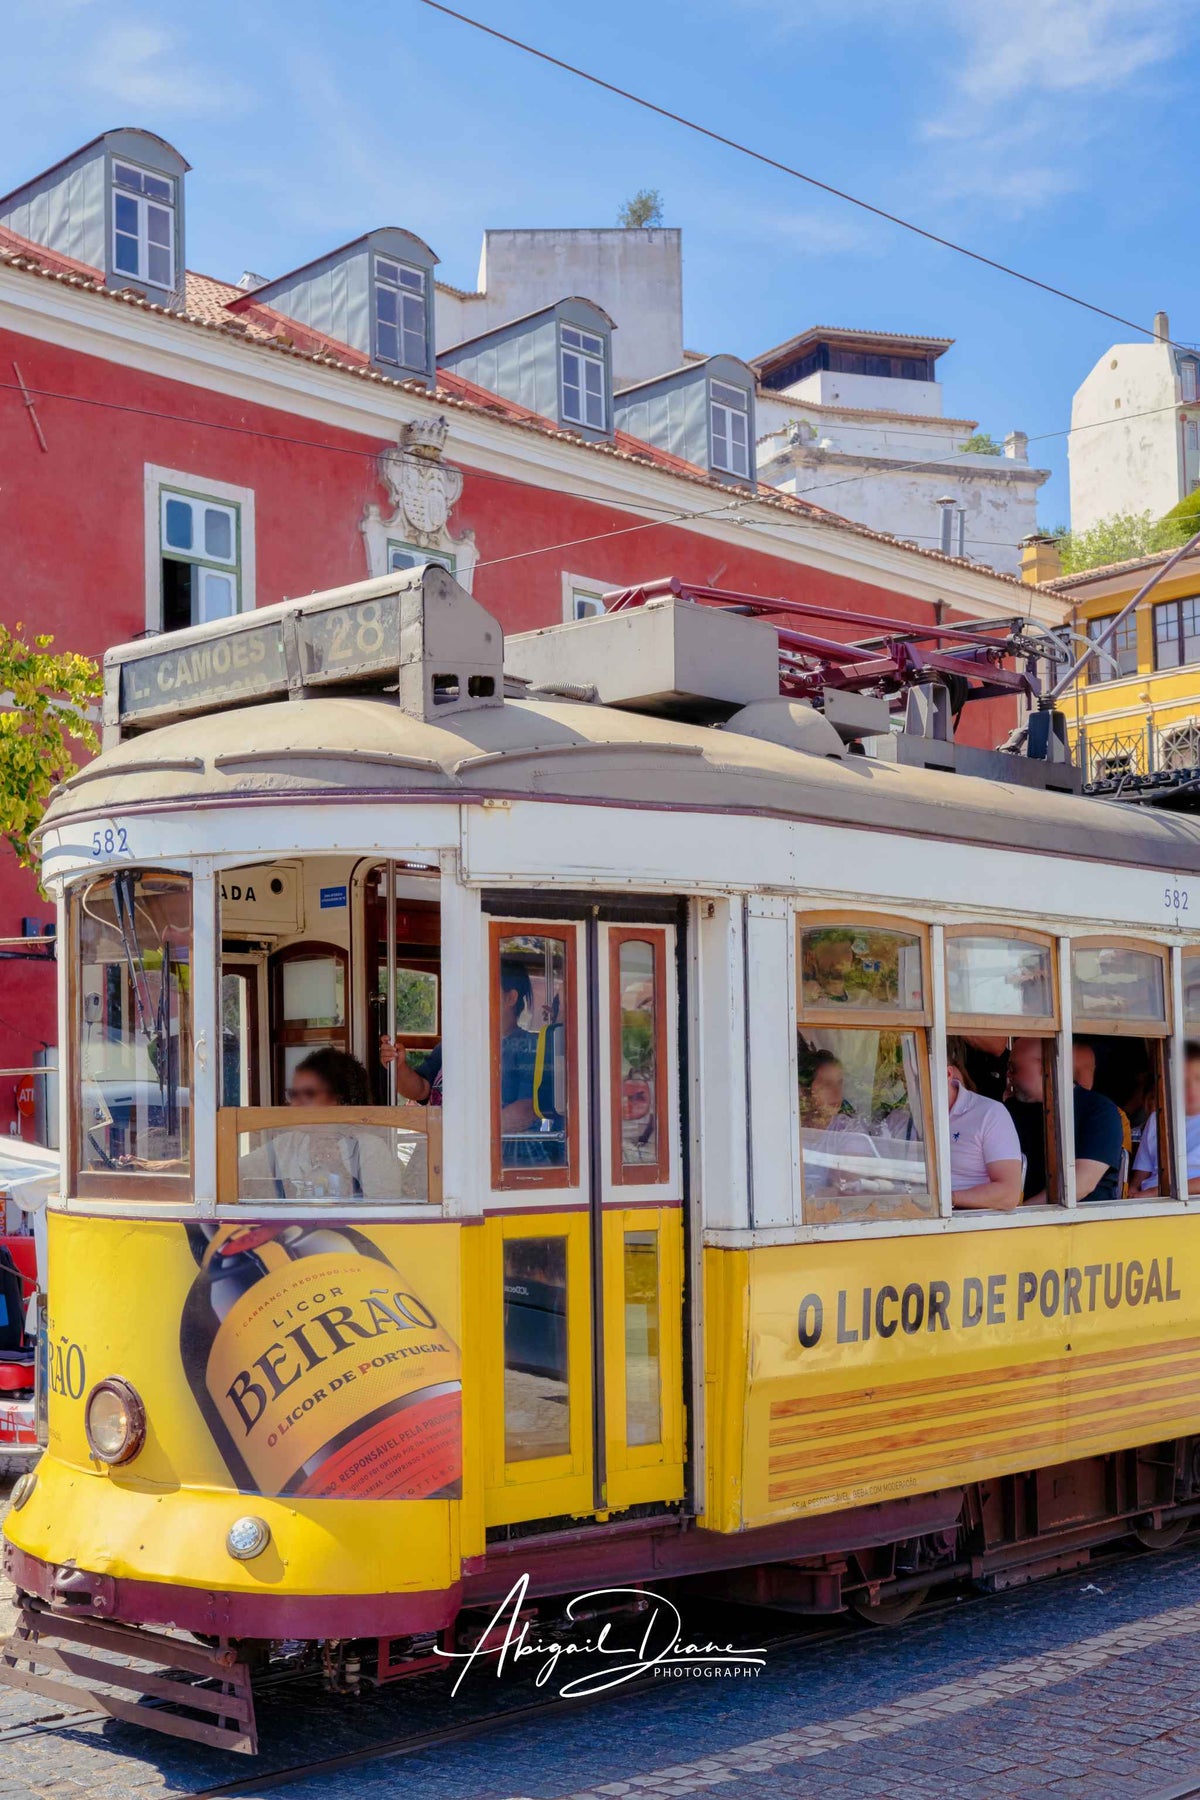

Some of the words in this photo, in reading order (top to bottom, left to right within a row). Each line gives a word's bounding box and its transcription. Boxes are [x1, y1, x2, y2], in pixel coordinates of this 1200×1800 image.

[325, 602, 385, 662] 28
[92, 827, 129, 856] 582
[1164, 888, 1189, 911] 582
[272, 1286, 345, 1329] LICOR
[797, 1293, 823, 1349] O
[836, 1279, 951, 1344] LICOR
[961, 1274, 1007, 1329] DE
[1016, 1256, 1182, 1321] PORTUGAL
[225, 1287, 438, 1437] BEIRÃO
[266, 1432, 278, 1448] O
[276, 1387, 329, 1435] LICOR
[328, 1369, 357, 1392] DE
[357, 1343, 450, 1376] PORTUGAL
[338, 1437, 401, 1484] RESPONSÁVEL
[399, 1424, 423, 1442] PELA
